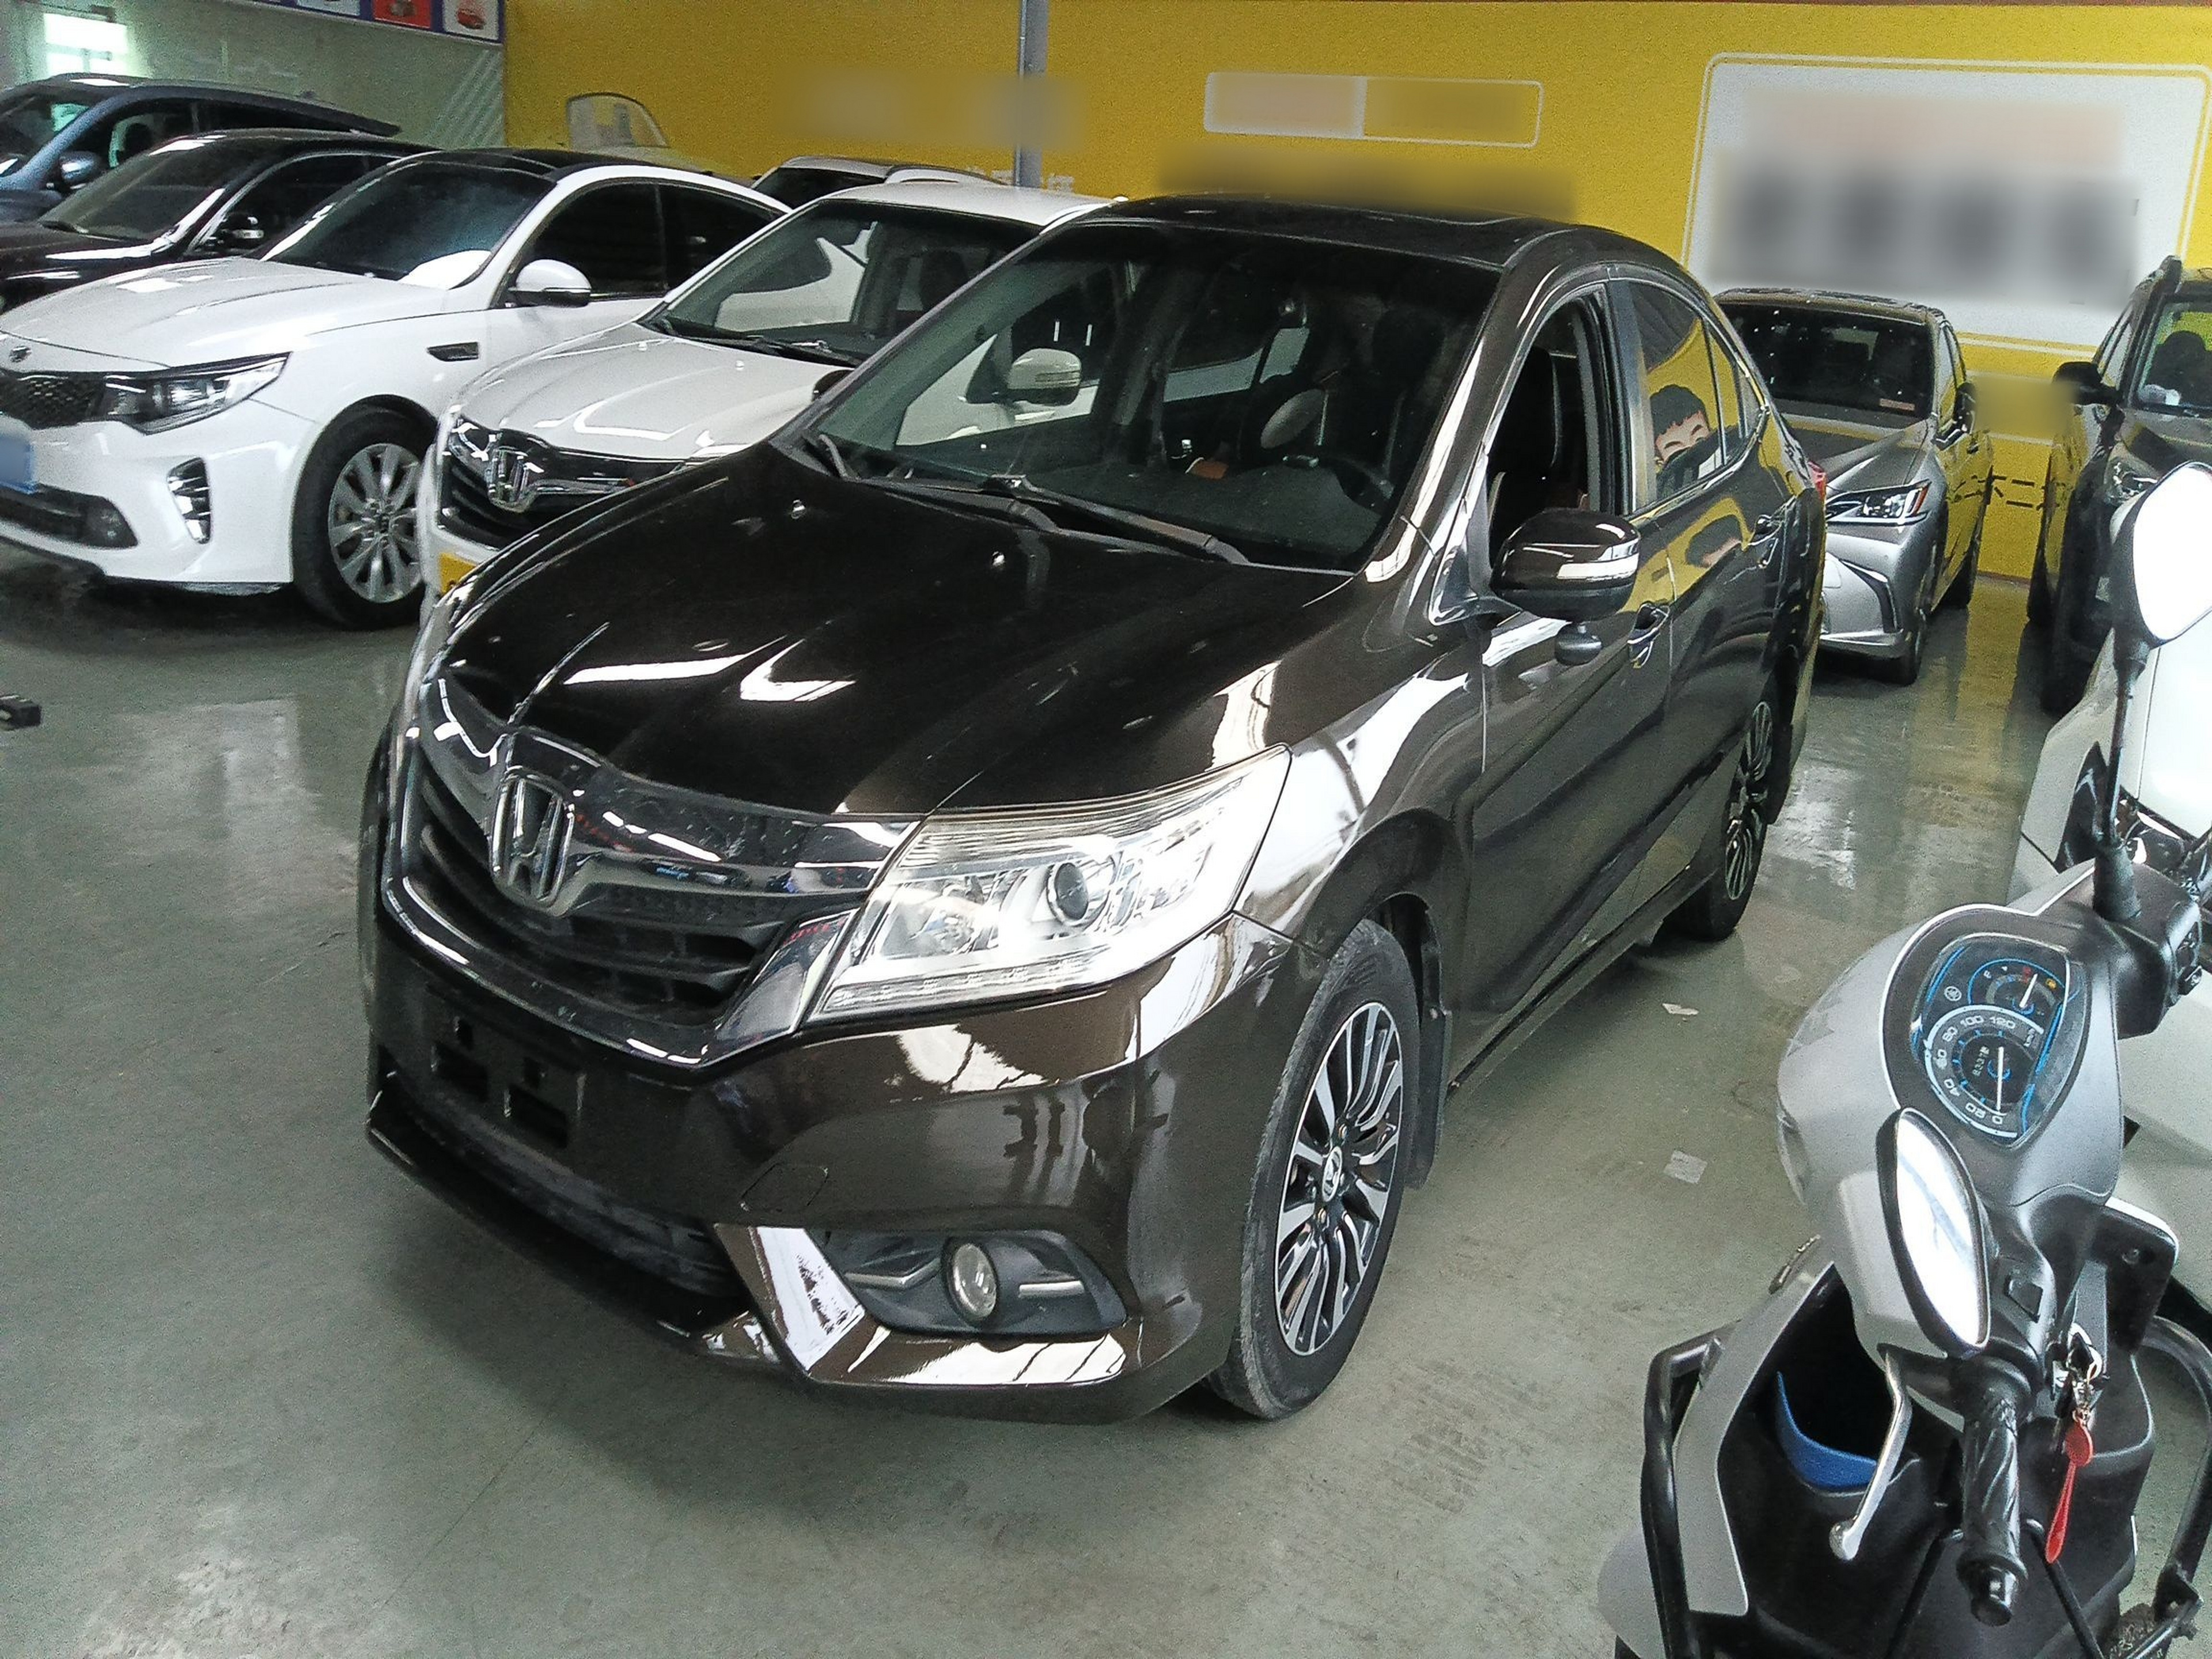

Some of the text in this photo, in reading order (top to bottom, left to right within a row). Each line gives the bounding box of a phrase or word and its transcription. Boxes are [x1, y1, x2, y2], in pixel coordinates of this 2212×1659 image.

[1960, 1014, 1984, 1028] 100
[1989, 1016, 2016, 1029] 120
[1942, 1026, 1959, 1043] 80
[1944, 1078, 1961, 1097] 40
[1965, 1101, 1987, 1119] 20
[1992, 1114, 2003, 1125] 0
